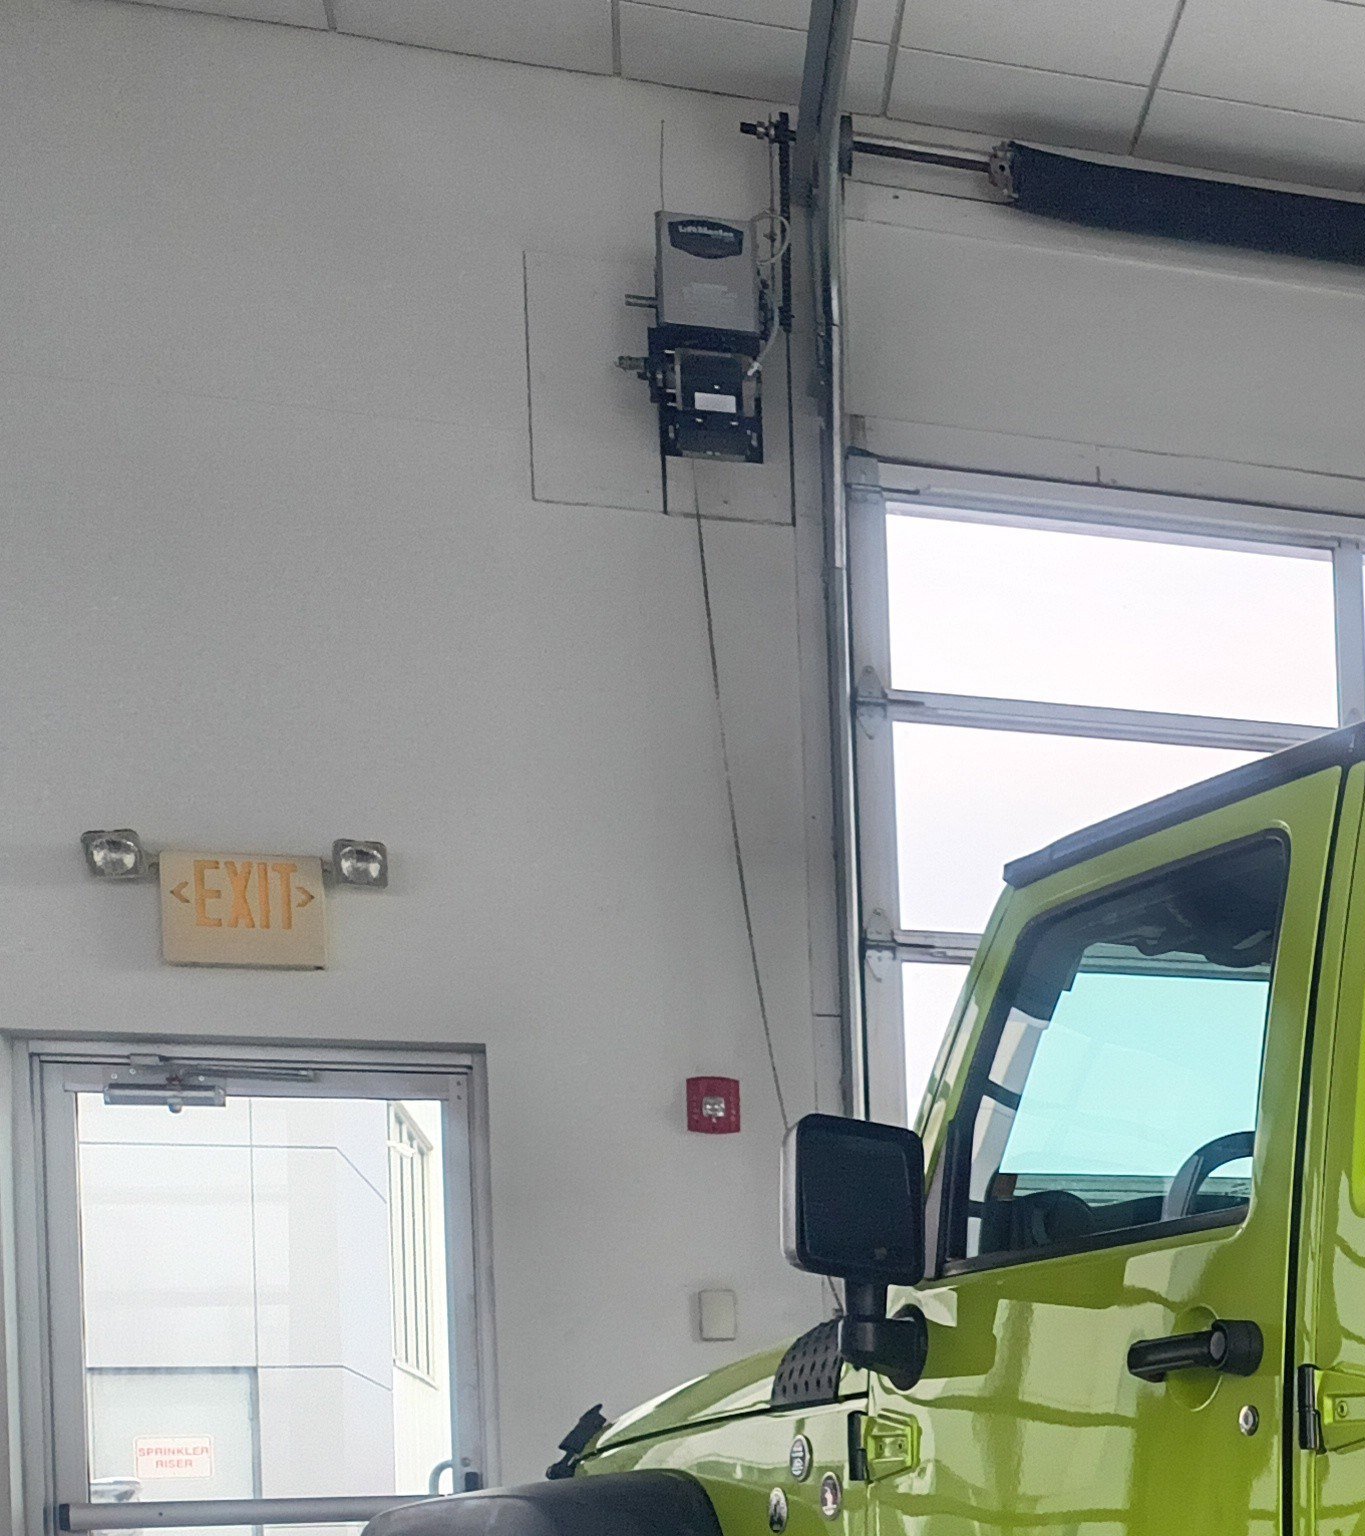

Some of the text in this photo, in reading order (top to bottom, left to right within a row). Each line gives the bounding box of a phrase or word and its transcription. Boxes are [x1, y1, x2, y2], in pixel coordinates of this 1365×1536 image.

[194, 859, 298, 930] EXIT
[138, 1446, 209, 1457] SPRINKLER
[156, 1459, 193, 1469] RISER
